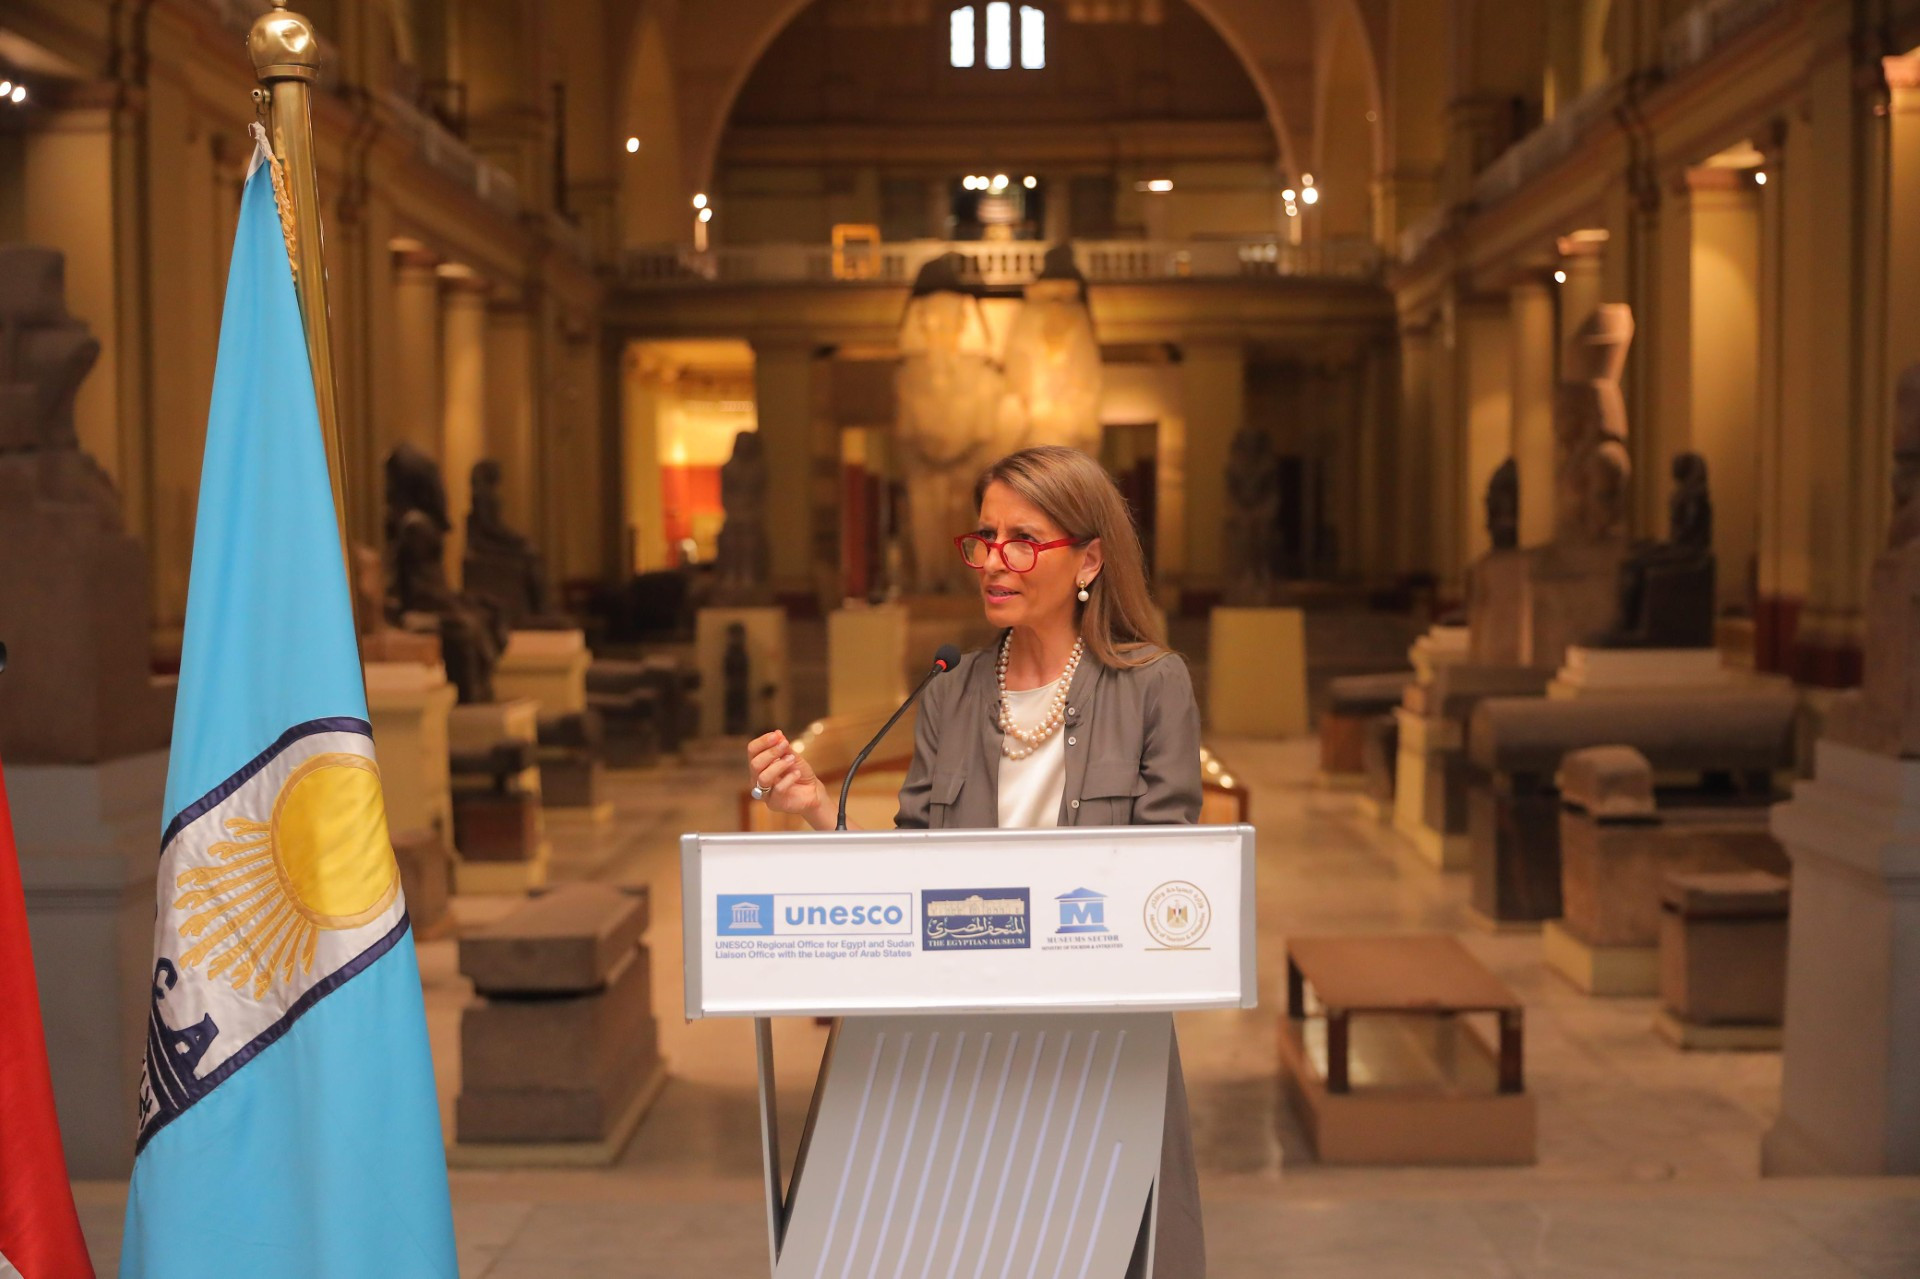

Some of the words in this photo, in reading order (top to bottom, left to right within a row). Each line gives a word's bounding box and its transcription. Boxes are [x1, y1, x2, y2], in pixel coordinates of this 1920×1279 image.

[785, 905, 903, 926] unesco
[1059, 902, 1104, 925] M
[715, 941, 754, 949] UNESCO
[757, 941, 795, 950] Regional
[797, 940, 824, 949] Office
[827, 940, 839, 948] for
[841, 940, 866, 950] Egypt
[868, 940, 884, 948] and
[887, 940, 915, 948] Sudan
[715, 951, 746, 959] Liaison
[748, 950, 775, 959] Office
[778, 950, 796, 958] with
[798, 950, 812, 958] the
[815, 950, 847, 960] League
[849, 950, 858, 958] of
[860, 949, 881, 957] Arab
[883, 949, 912, 957] States
